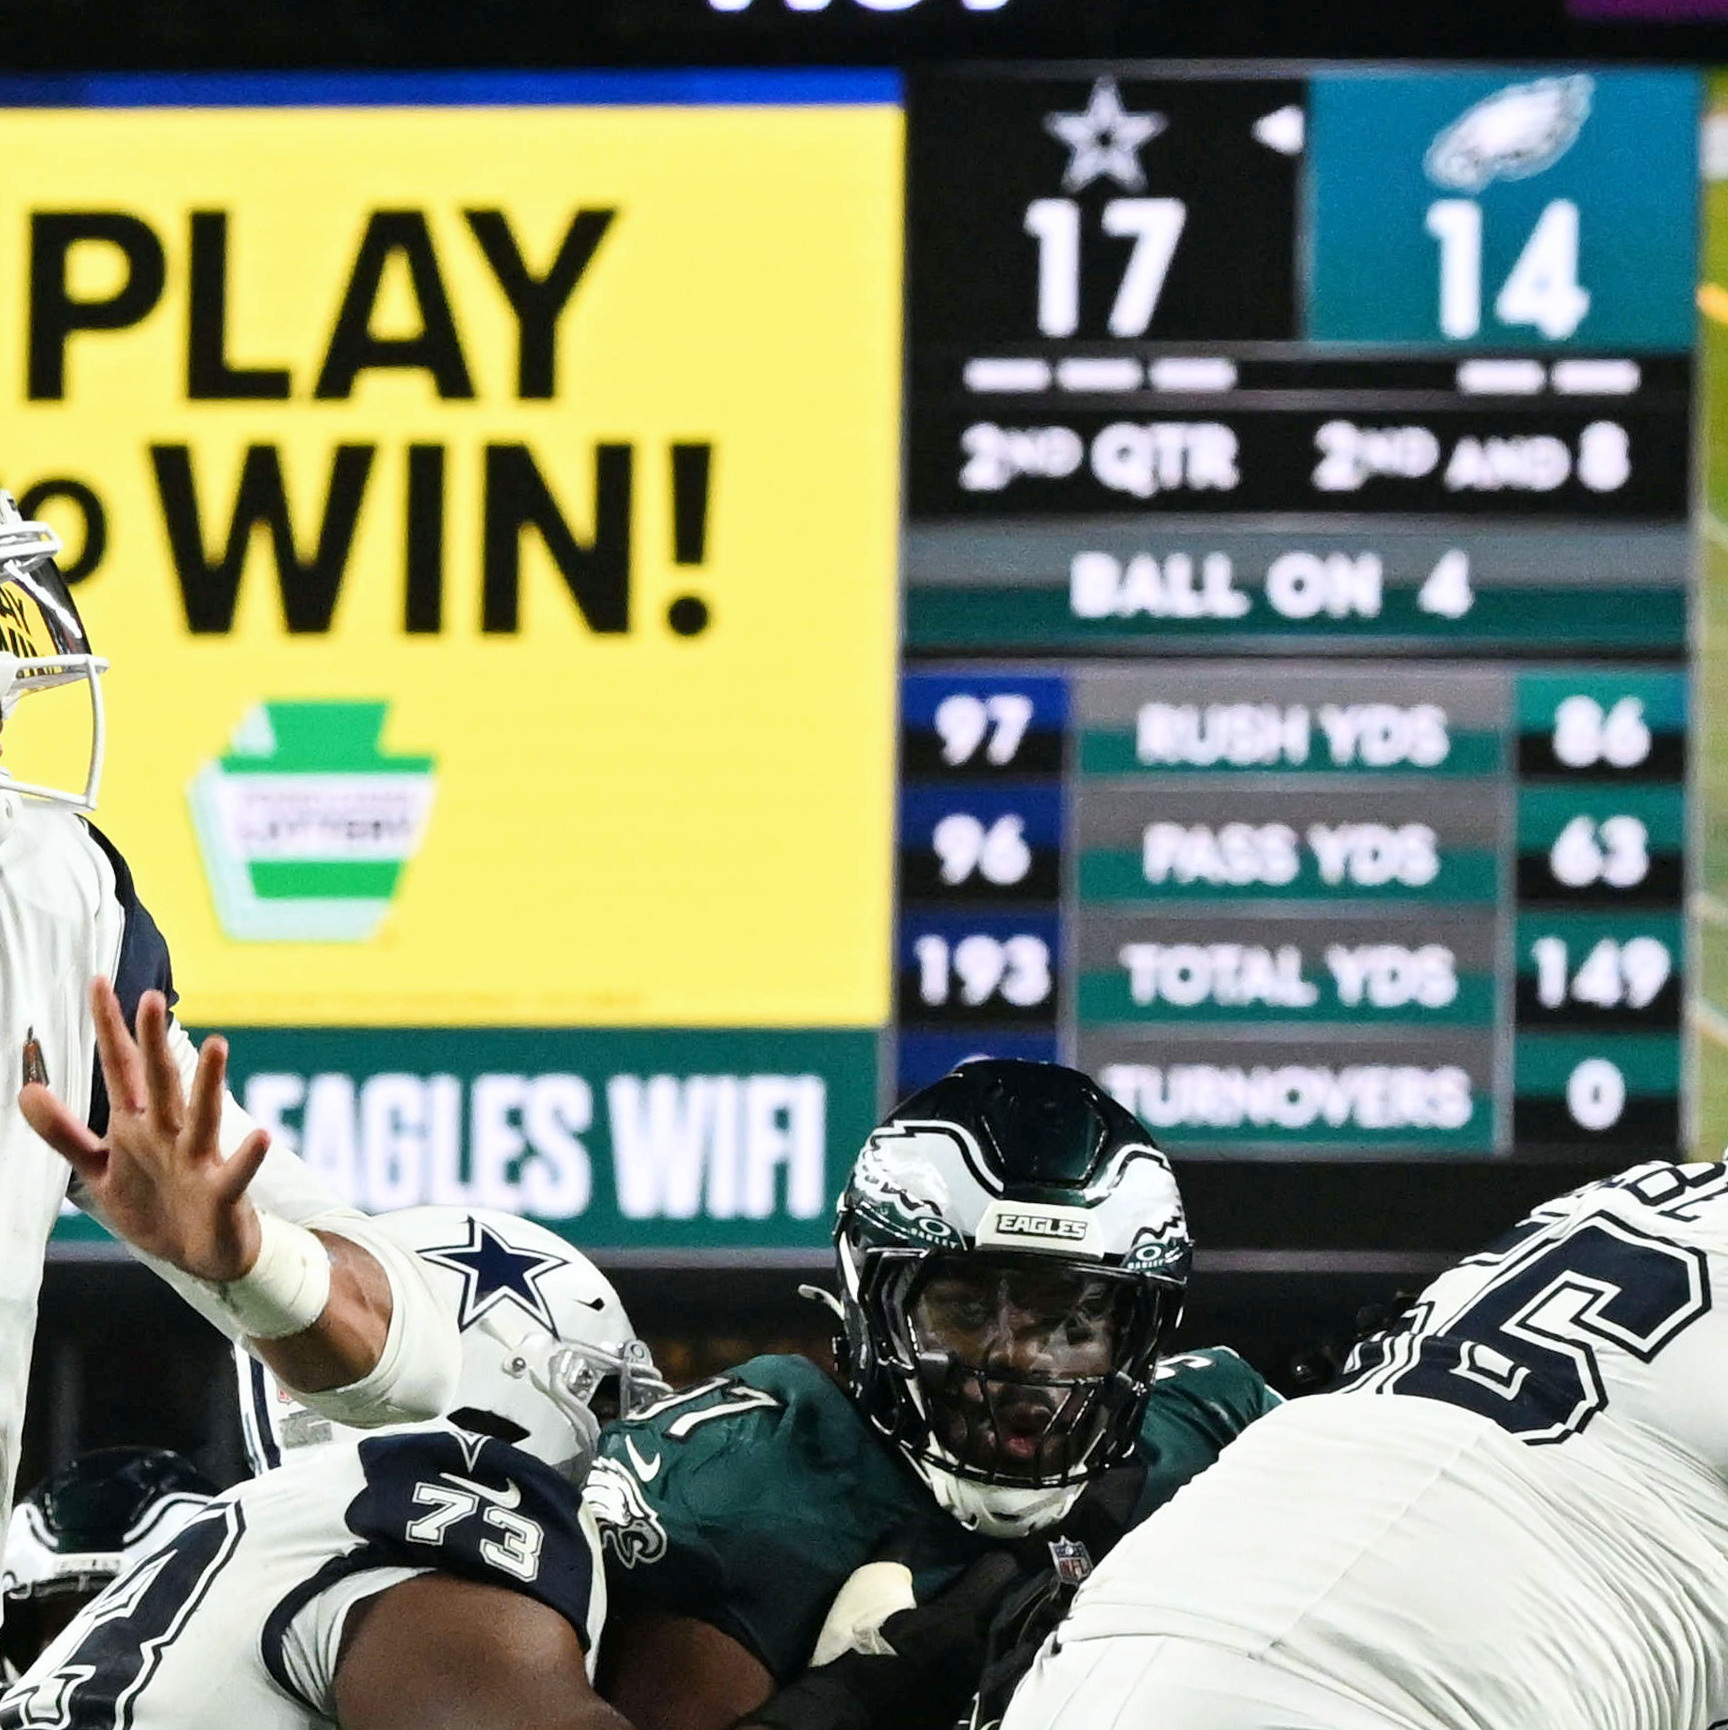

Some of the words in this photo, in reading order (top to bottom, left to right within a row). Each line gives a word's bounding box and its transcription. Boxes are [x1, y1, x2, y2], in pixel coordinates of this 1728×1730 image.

[24, 207, 618, 402] PLAY
[1025, 198, 1187, 339] 17
[1426, 198, 1590, 341] 14
[960, 421, 1084, 492] 2ND
[1090, 422, 1241, 498] QTR
[1312, 421, 1440, 492] 2ND
[1443, 436, 1572, 493] AND
[1578, 420, 1632, 492] 8
[148, 441, 715, 640] WIN!
[1071, 550, 1253, 619] BALL
[1265, 550, 1383, 619] ON
[1417, 547, 1475, 619] 4
[933, 692, 1035, 767] 97
[1135, 702, 1310, 767] RUSH
[1317, 703, 1450, 768] YDS
[1551, 693, 1652, 769] 86
[932, 812, 1032, 886] 96
[1141, 823, 1300, 888] PASS
[1307, 824, 1441, 888] YDS
[1549, 813, 1651, 889] 63
[912, 932, 1052, 1006] 193
[1119, 943, 1319, 1009] TOTAL
[1326, 943, 1459, 1009] YDS
[1530, 935, 1672, 1011] 149
[1100, 1063, 1473, 1131] TURNOVERS
[1567, 1056, 1627, 1131] 0
[608, 1072, 826, 1219] WIFI
[909, 1228, 958, 1250] OAKLEY
[996, 1213, 1089, 1241] EAGLES
[405, 1481, 545, 1584] 73
